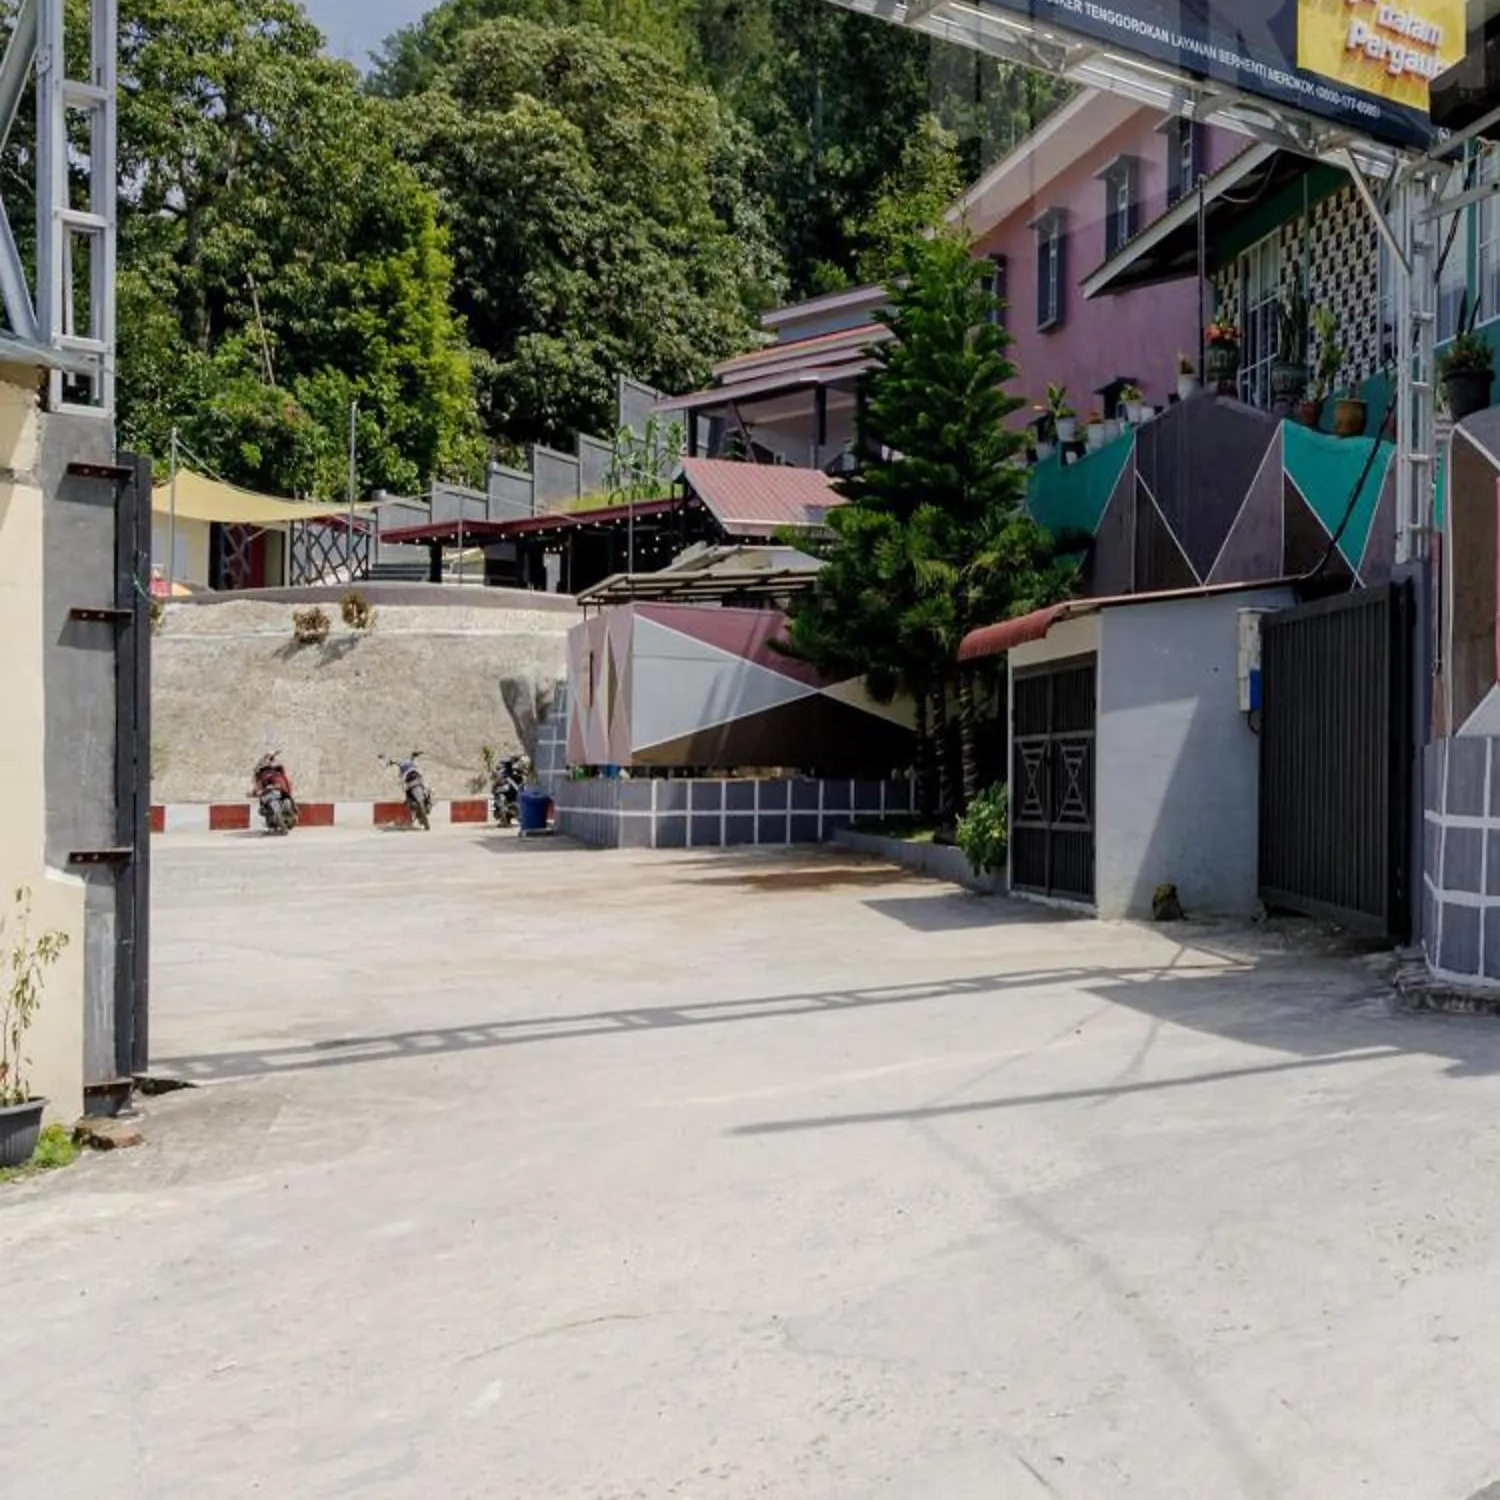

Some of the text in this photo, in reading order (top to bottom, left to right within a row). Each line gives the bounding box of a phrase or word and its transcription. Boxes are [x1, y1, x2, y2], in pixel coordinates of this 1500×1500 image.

[1084, 2, 1170, 44] TENGGOROKAN
[1170, 31, 1217, 60] LAYANAN
[1377, 0, 1443, 48] dalam
